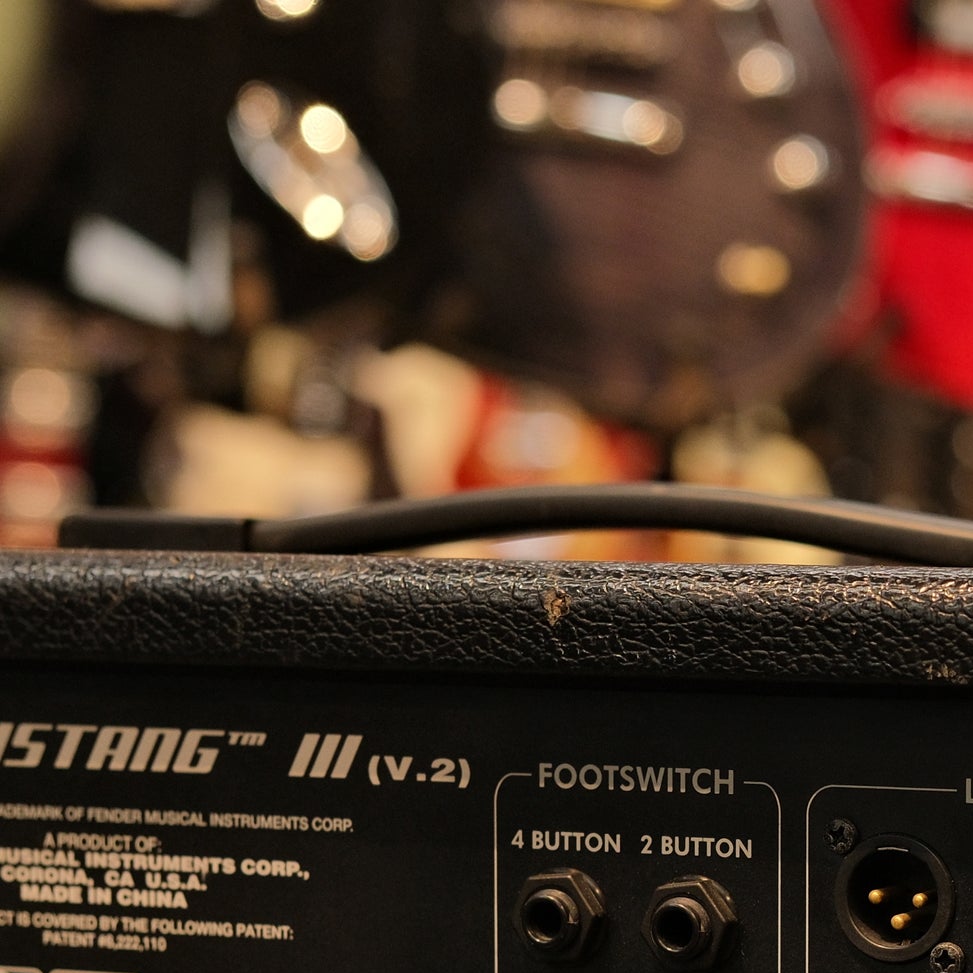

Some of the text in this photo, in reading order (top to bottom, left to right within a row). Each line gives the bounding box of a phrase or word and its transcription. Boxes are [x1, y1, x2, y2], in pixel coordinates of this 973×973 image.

[368, 754, 472, 789] (V.2)
[538, 762, 735, 795] FOOTSWITCH
[65, 806, 84, 822] OF
[87, 806, 142, 824] FENDER
[144, 809, 207, 826] MUSICAL
[210, 812, 309, 831] INSTRUMENTS
[311, 817, 354, 833] CORP.
[43, 832, 56, 849] A
[57, 832, 132, 851] PRODUCT
[511, 830, 621, 853] 4 BUTTON
[640, 835, 753, 859] 2 BUTTON
[85, 851, 236, 875] INSTRUMENTS
[0, 865, 208, 891] CORONA, CA U.S.A.
[20, 884, 188, 909] MADE IN CHINA
[15, 909, 31, 928] IS
[32, 911, 98, 931] COVERED
[99, 915, 120, 932] BY
[120, 916, 149, 934] THE
[150, 918, 234, 938] FOLLOWING
[236, 922, 294, 940] PATENT:
[42, 930, 96, 948] PATENT
